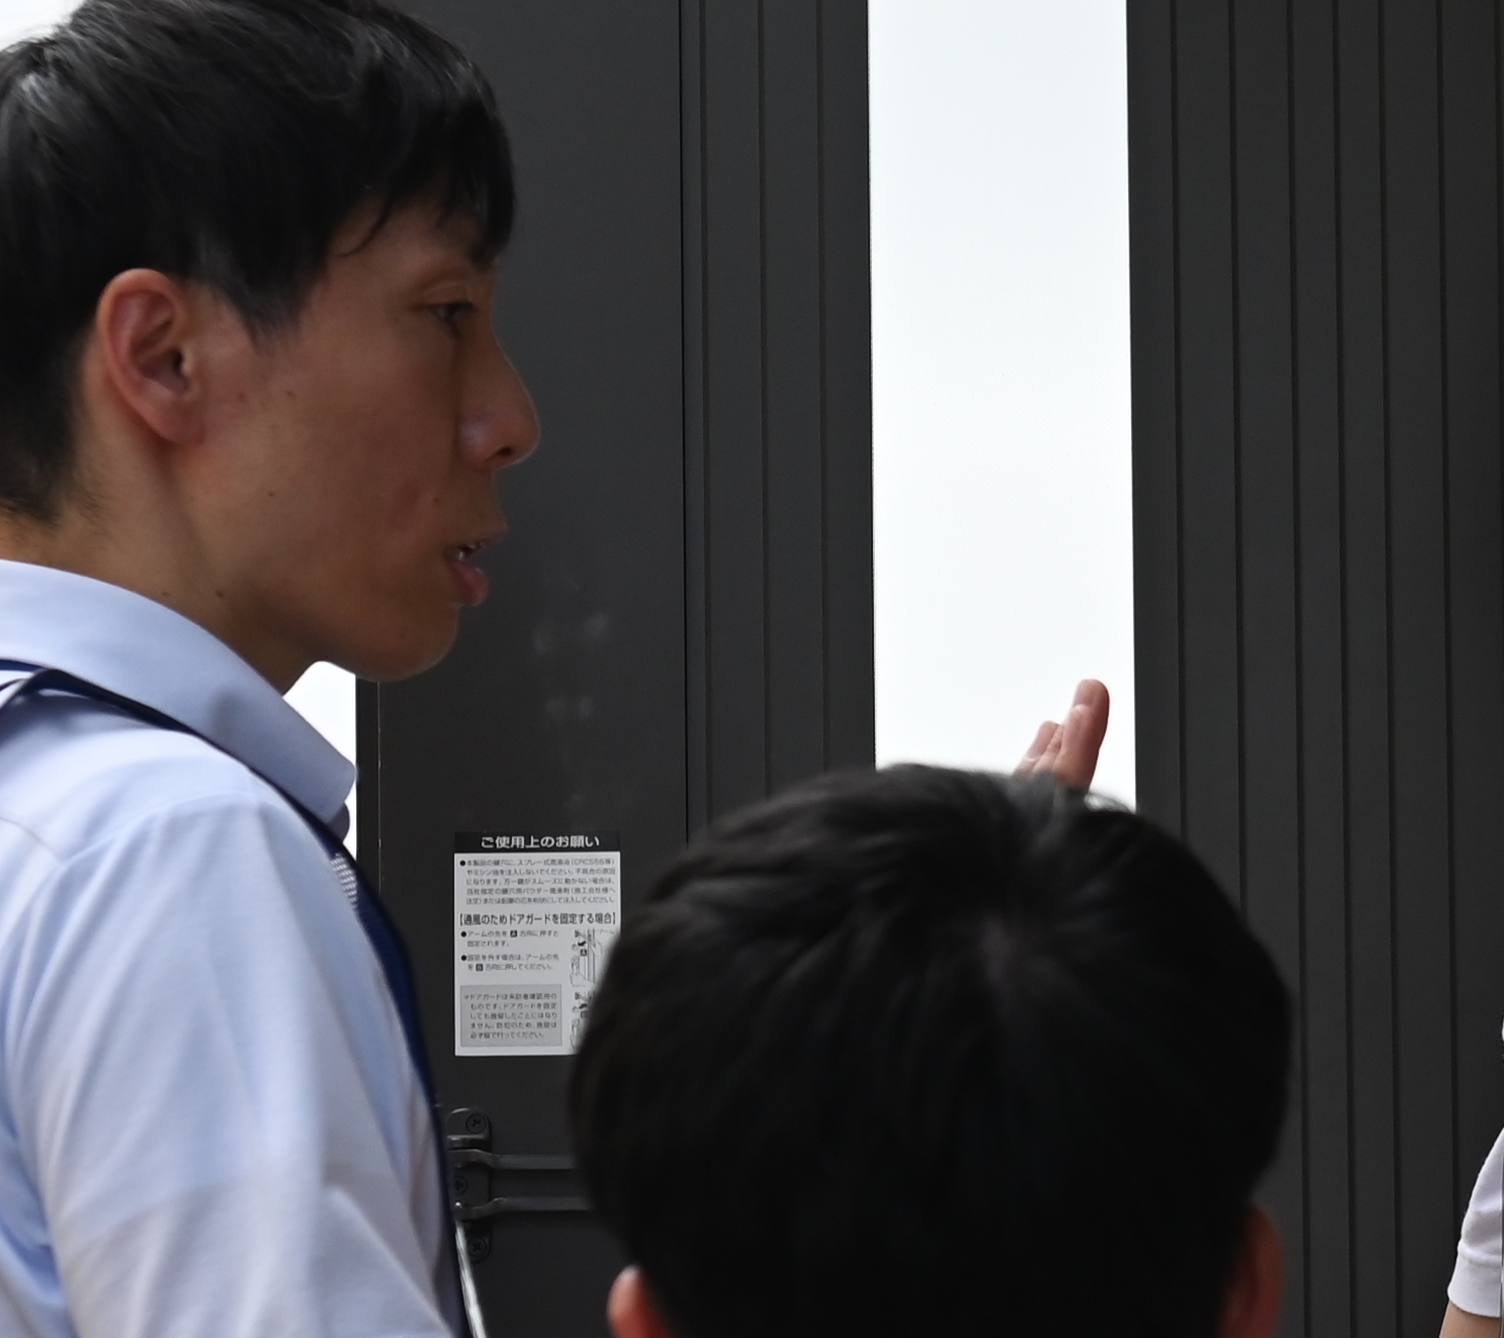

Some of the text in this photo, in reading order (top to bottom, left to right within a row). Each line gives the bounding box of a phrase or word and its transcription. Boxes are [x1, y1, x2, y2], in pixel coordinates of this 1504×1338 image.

[481, 835, 600, 849] ご使用上のお願い
